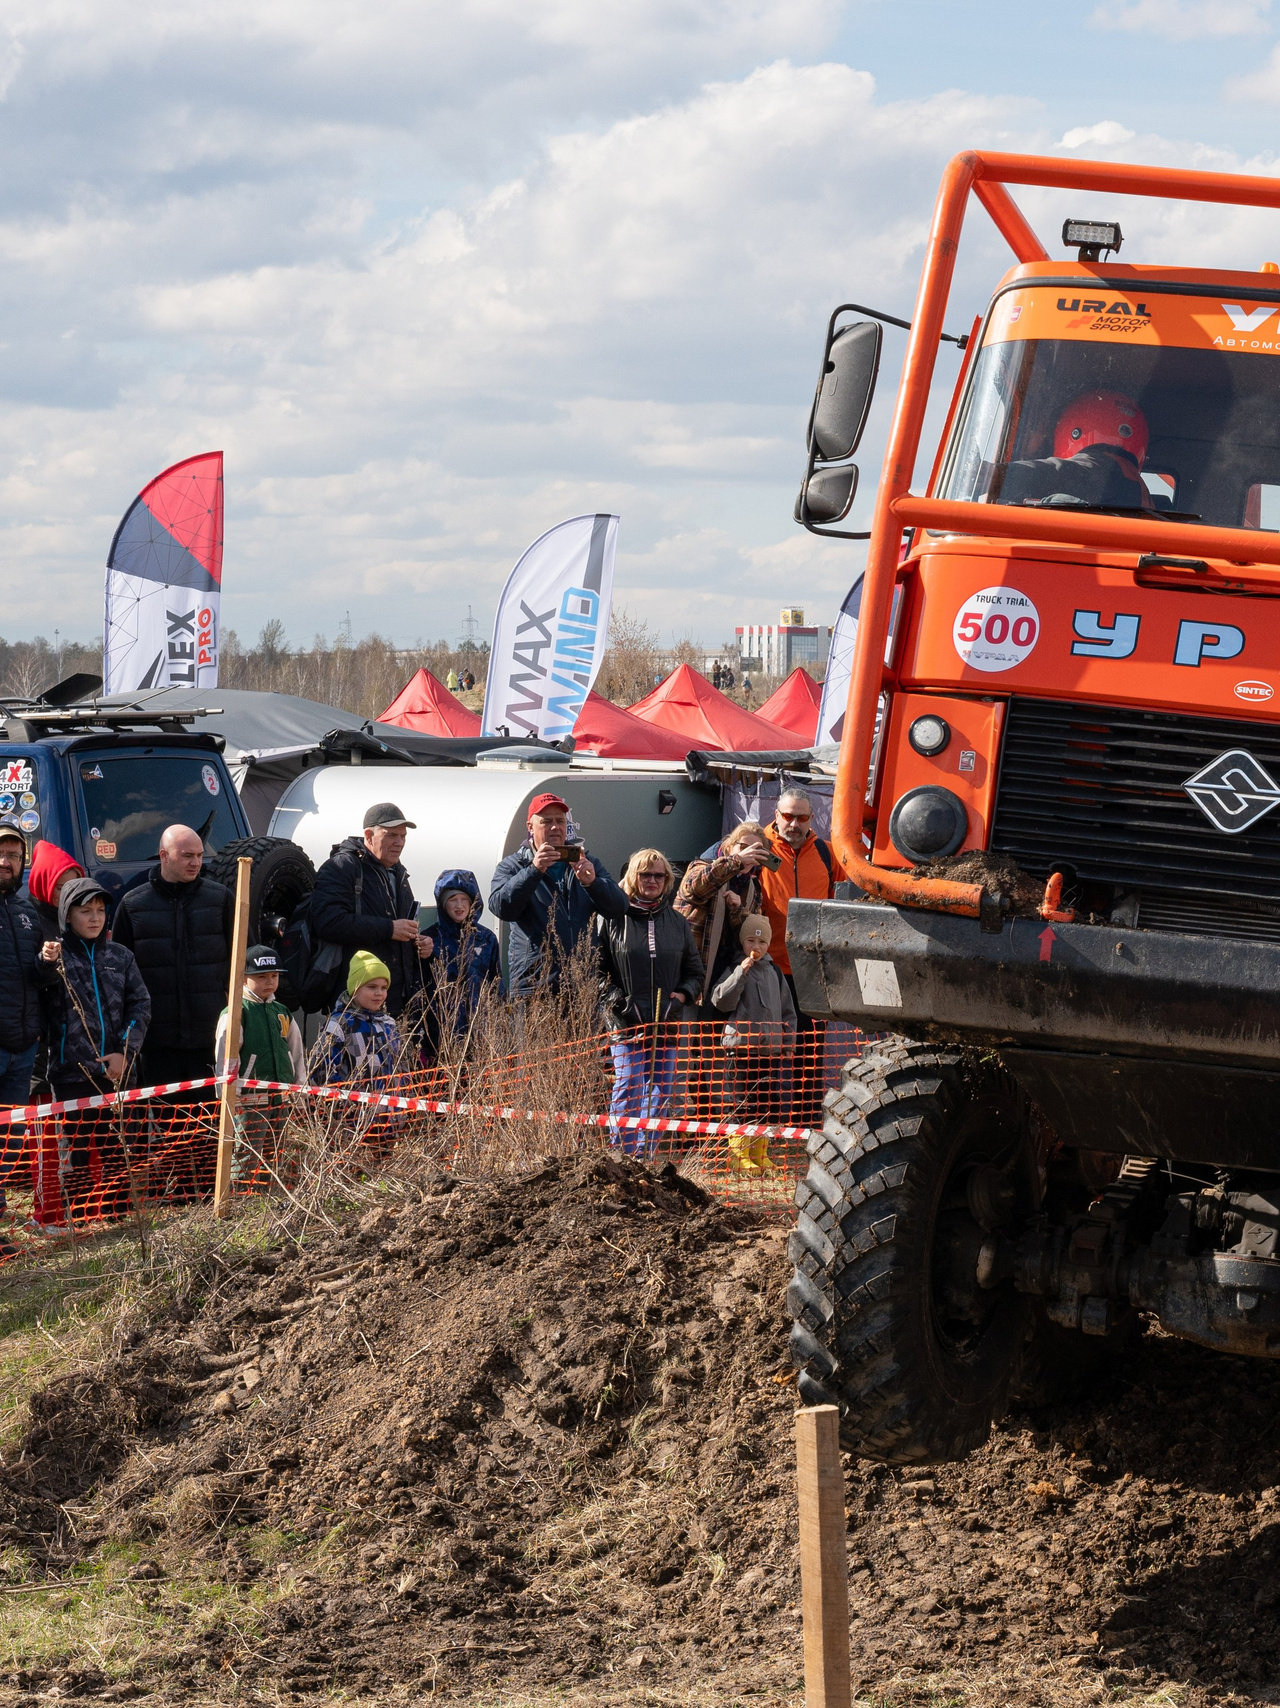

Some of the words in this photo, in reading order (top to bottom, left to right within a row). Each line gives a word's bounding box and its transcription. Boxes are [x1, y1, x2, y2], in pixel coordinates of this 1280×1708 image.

[1057, 298, 1152, 317] URAL
[1090, 323, 1142, 333] SPORT
[1096, 316, 1151, 327] MOTOR
[976, 594, 1003, 605] TRUCK
[1006, 597, 1030, 607] TRIAL
[198, 607, 212, 665] PRO
[957, 612, 1037, 647] 500
[165, 609, 195, 688] LEX
[505, 599, 557, 734] MAX
[543, 586, 601, 736] WIND
[1236, 686, 1272, 697] SINTEC
[97, 844, 115, 854] RED
[253, 956, 277, 967] VANS
